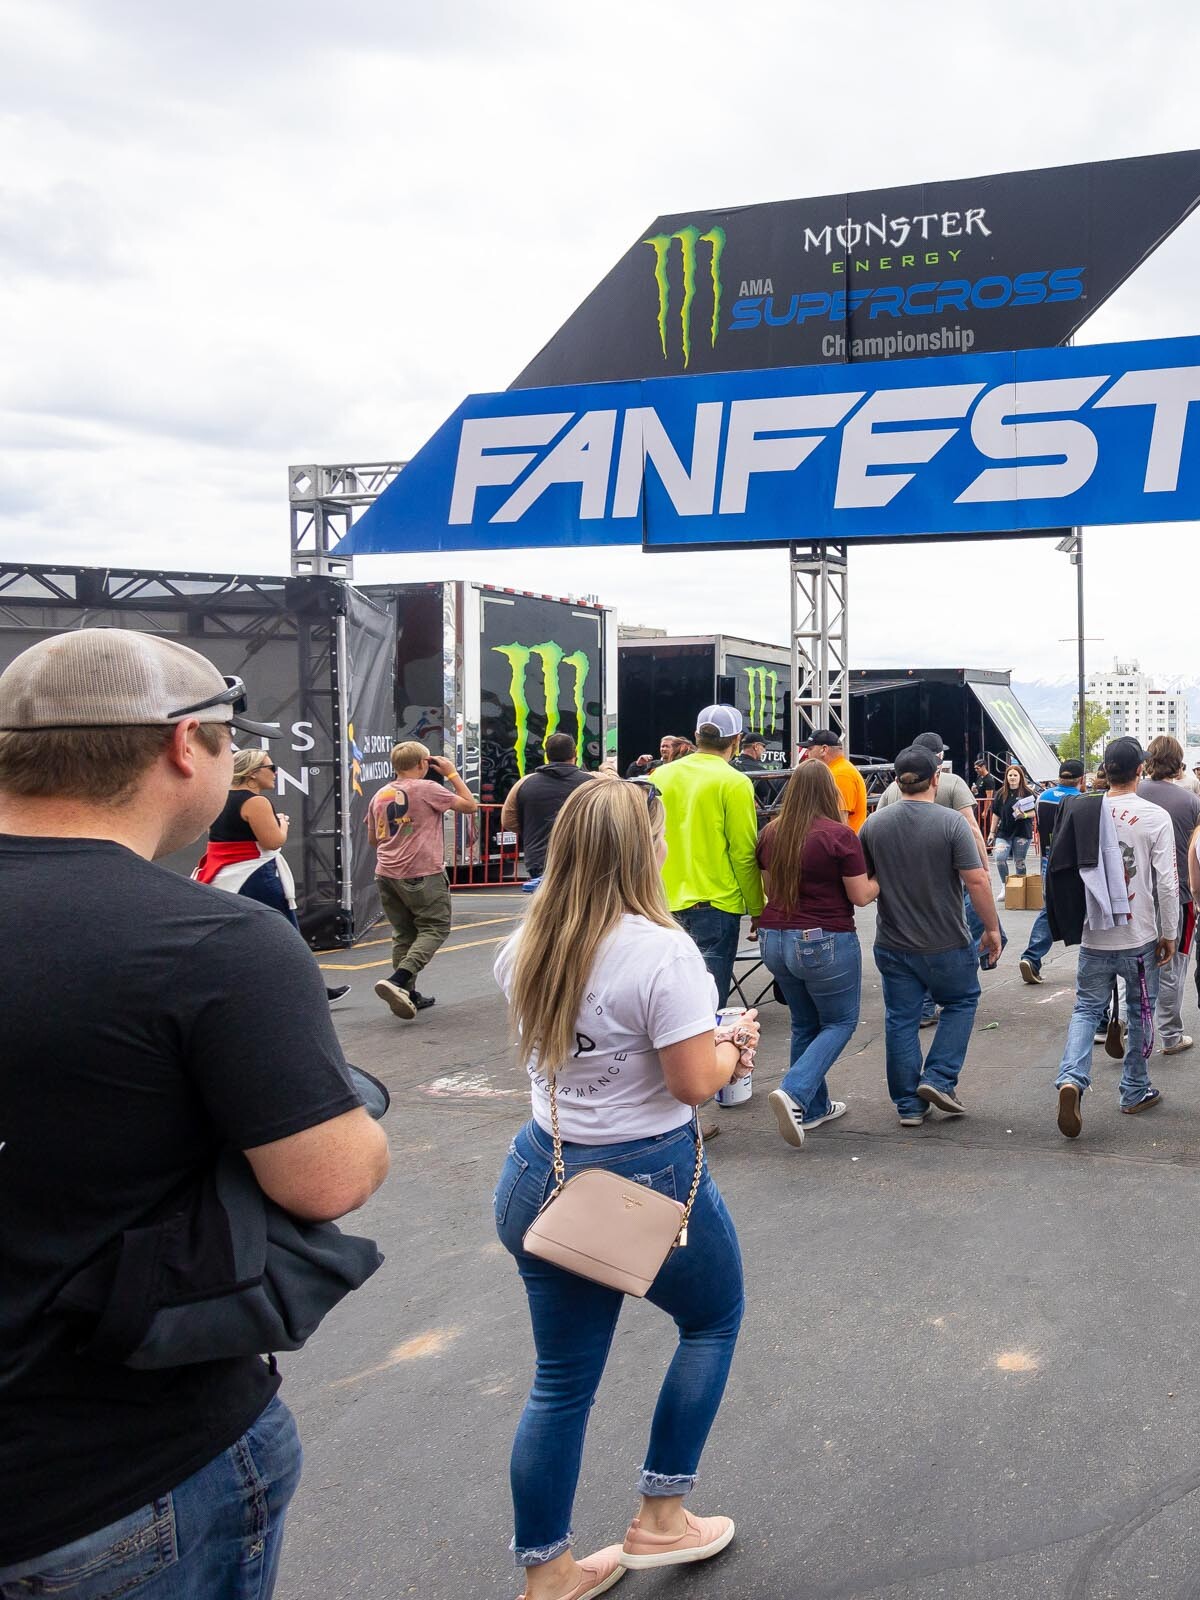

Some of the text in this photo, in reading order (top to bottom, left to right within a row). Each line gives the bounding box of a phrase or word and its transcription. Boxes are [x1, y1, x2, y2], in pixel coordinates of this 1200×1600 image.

[803, 206, 992, 255] MONSTER
[832, 249, 966, 274] ENERGY
[728, 266, 1086, 330] SUPERCROSS
[738, 279, 774, 298] AMA
[821, 325, 975, 359] Championship
